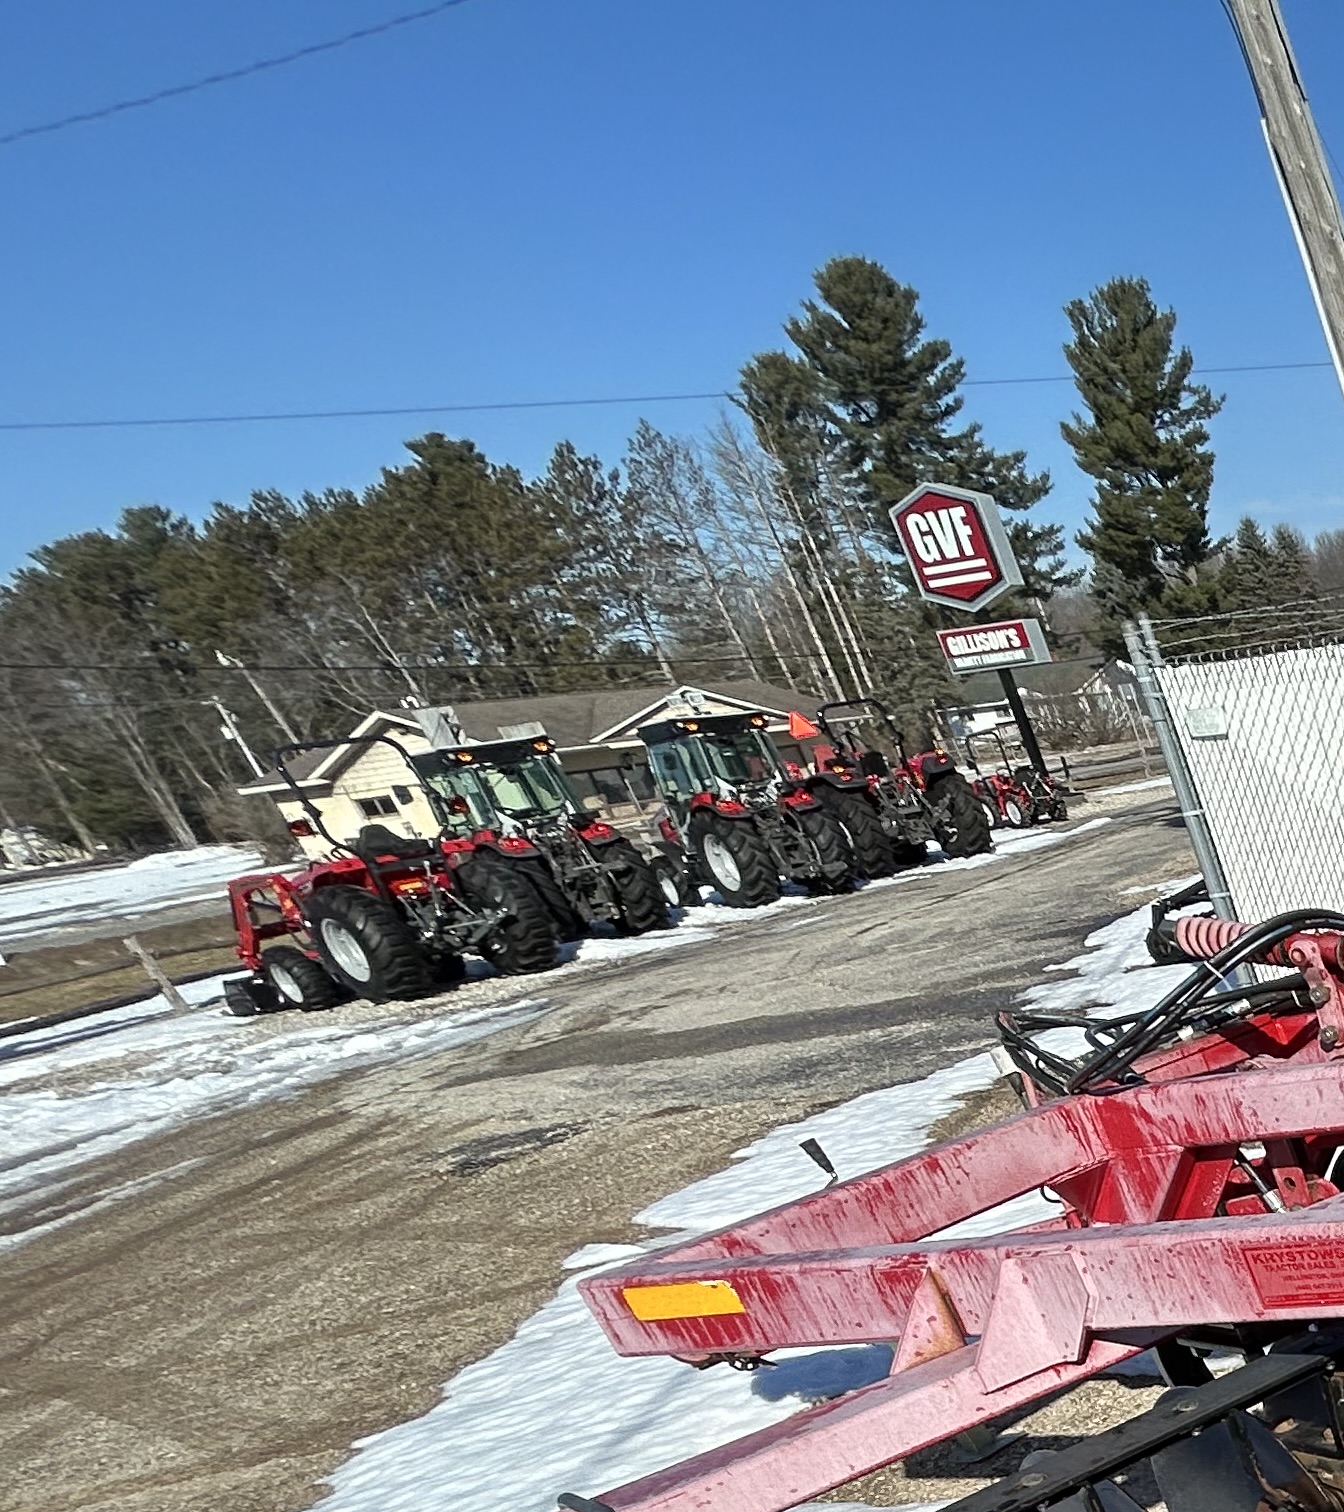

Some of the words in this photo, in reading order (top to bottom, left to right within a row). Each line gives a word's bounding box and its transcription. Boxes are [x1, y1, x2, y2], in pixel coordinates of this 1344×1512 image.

[906, 505, 975, 563] GVF
[946, 628, 1021, 656] GILLISON'S
[1263, 1262, 1306, 1273] TRACTOR
